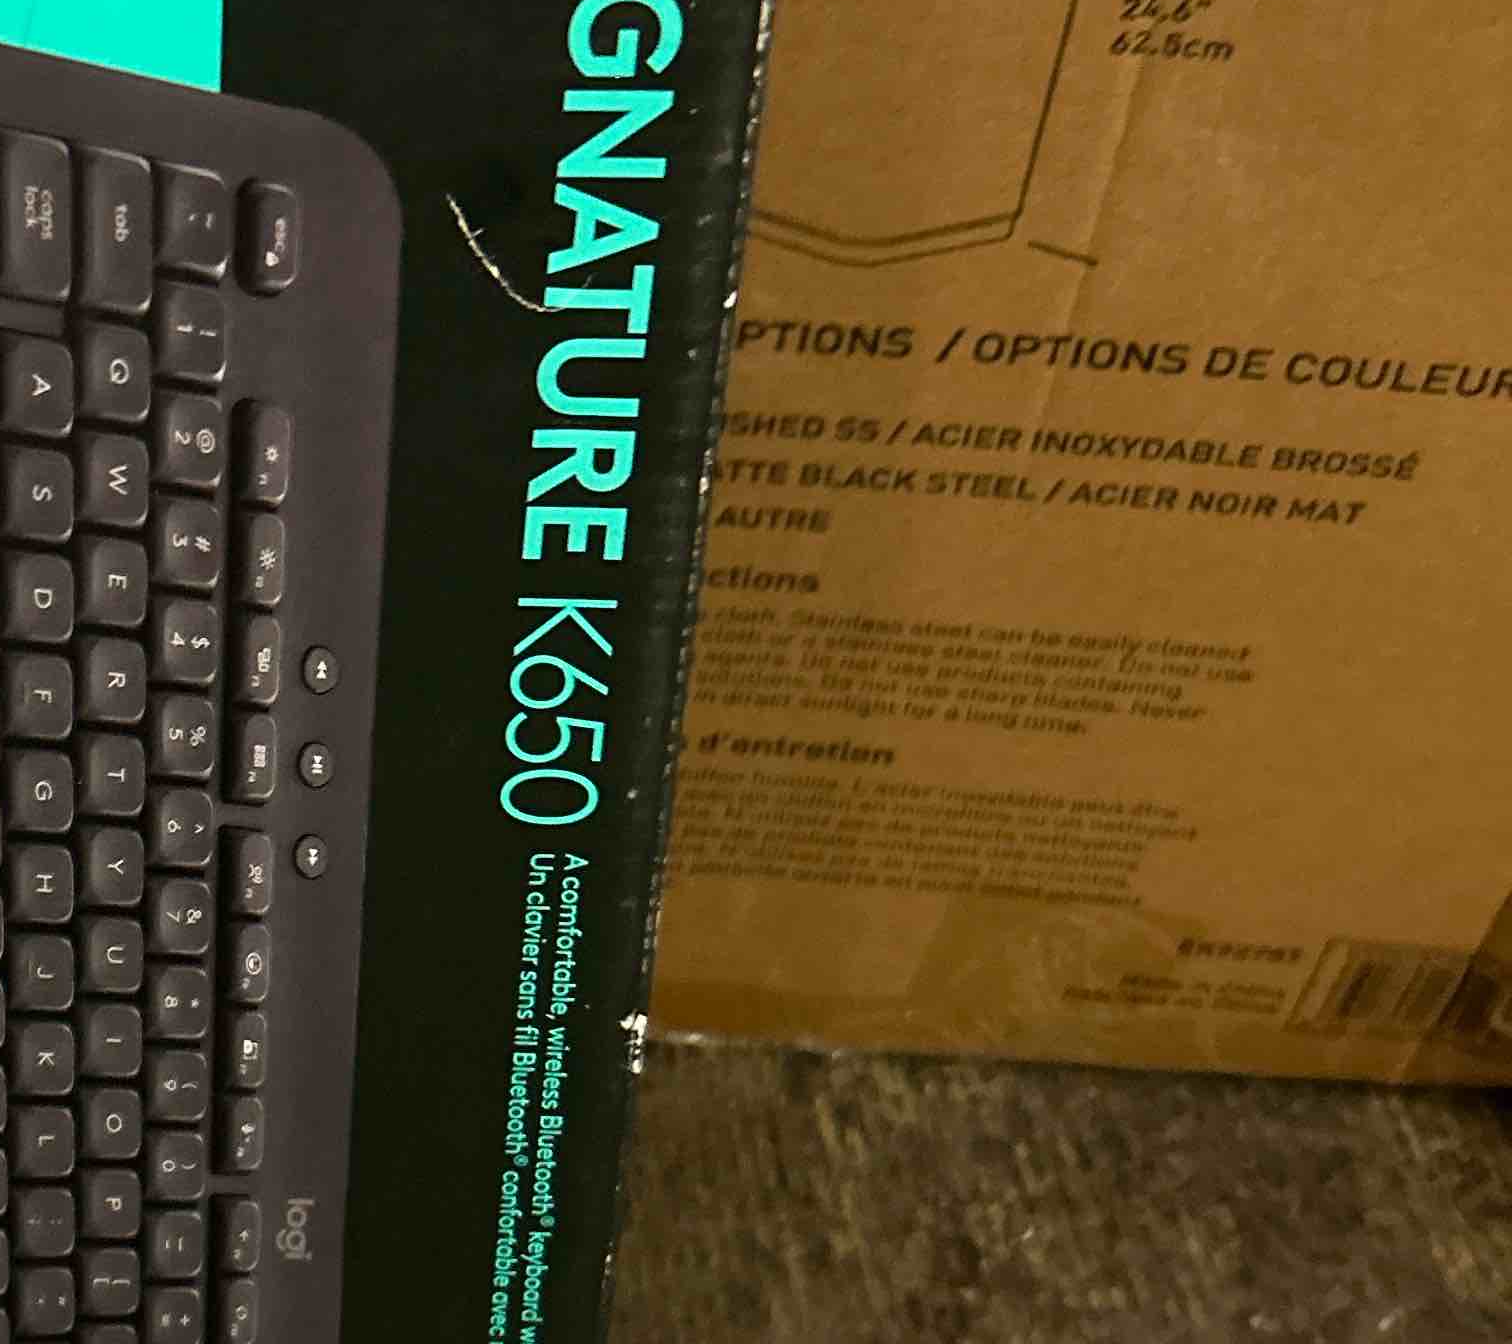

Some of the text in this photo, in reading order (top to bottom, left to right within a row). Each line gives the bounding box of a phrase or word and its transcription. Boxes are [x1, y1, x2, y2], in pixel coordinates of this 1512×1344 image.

[110, 201, 133, 245] tab
[106, 356, 132, 385] Q
[735, 319, 1512, 399] PTIONS / OPTIONS DE COULEUR
[31, 372, 53, 398] A
[172, 429, 191, 447] 2
[911, 423, 1023, 452] ACIER
[1031, 429, 1265, 470] INOXYDABLE
[1270, 447, 1422, 483] BROSSÉ
[106, 463, 131, 496] W
[32, 483, 54, 505] S
[799, 463, 919, 493] BLACK
[925, 469, 1037, 502] STEEL
[1068, 480, 1180, 512] ACIER
[1188, 489, 1279, 520] NOIR
[1285, 498, 1369, 527] MAT
[714, 505, 831, 534] AUTRE
[171, 532, 190, 550] 3
[193, 533, 213, 555] #
[106, 572, 127, 592] E
[32, 586, 54, 612] D
[169, 630, 187, 648] 4
[106, 669, 127, 692] R
[33, 686, 54, 706] F
[499, 597, 618, 826] K650
[168, 726, 184, 742] 5
[189, 722, 207, 748] %
[106, 766, 127, 785] T
[33, 778, 55, 803] G
[165, 818, 182, 835] 6
[105, 855, 125, 878] Y
[528, 852, 556, 887] Un
[563, 853, 589, 871] A
[34, 872, 56, 895] H
[520, 891, 551, 967] clavier
[104, 944, 124, 966] U
[544, 875, 583, 1021] comfortable,
[35, 965, 57, 981] J
[163, 994, 180, 1010] 8
[515, 969, 538, 1021] sans
[512, 1024, 540, 1047] fil
[35, 1049, 56, 1069] K
[540, 1026, 571, 1109] wireless
[163, 1077, 178, 1092] 9
[37, 1134, 56, 1148] L
[104, 1195, 123, 1212] P
[275, 1197, 316, 1262] logi
[492, 1169, 524, 1288] confortable
[520, 1230, 553, 1324] keyboard
[488, 1290, 509, 1338] avec
